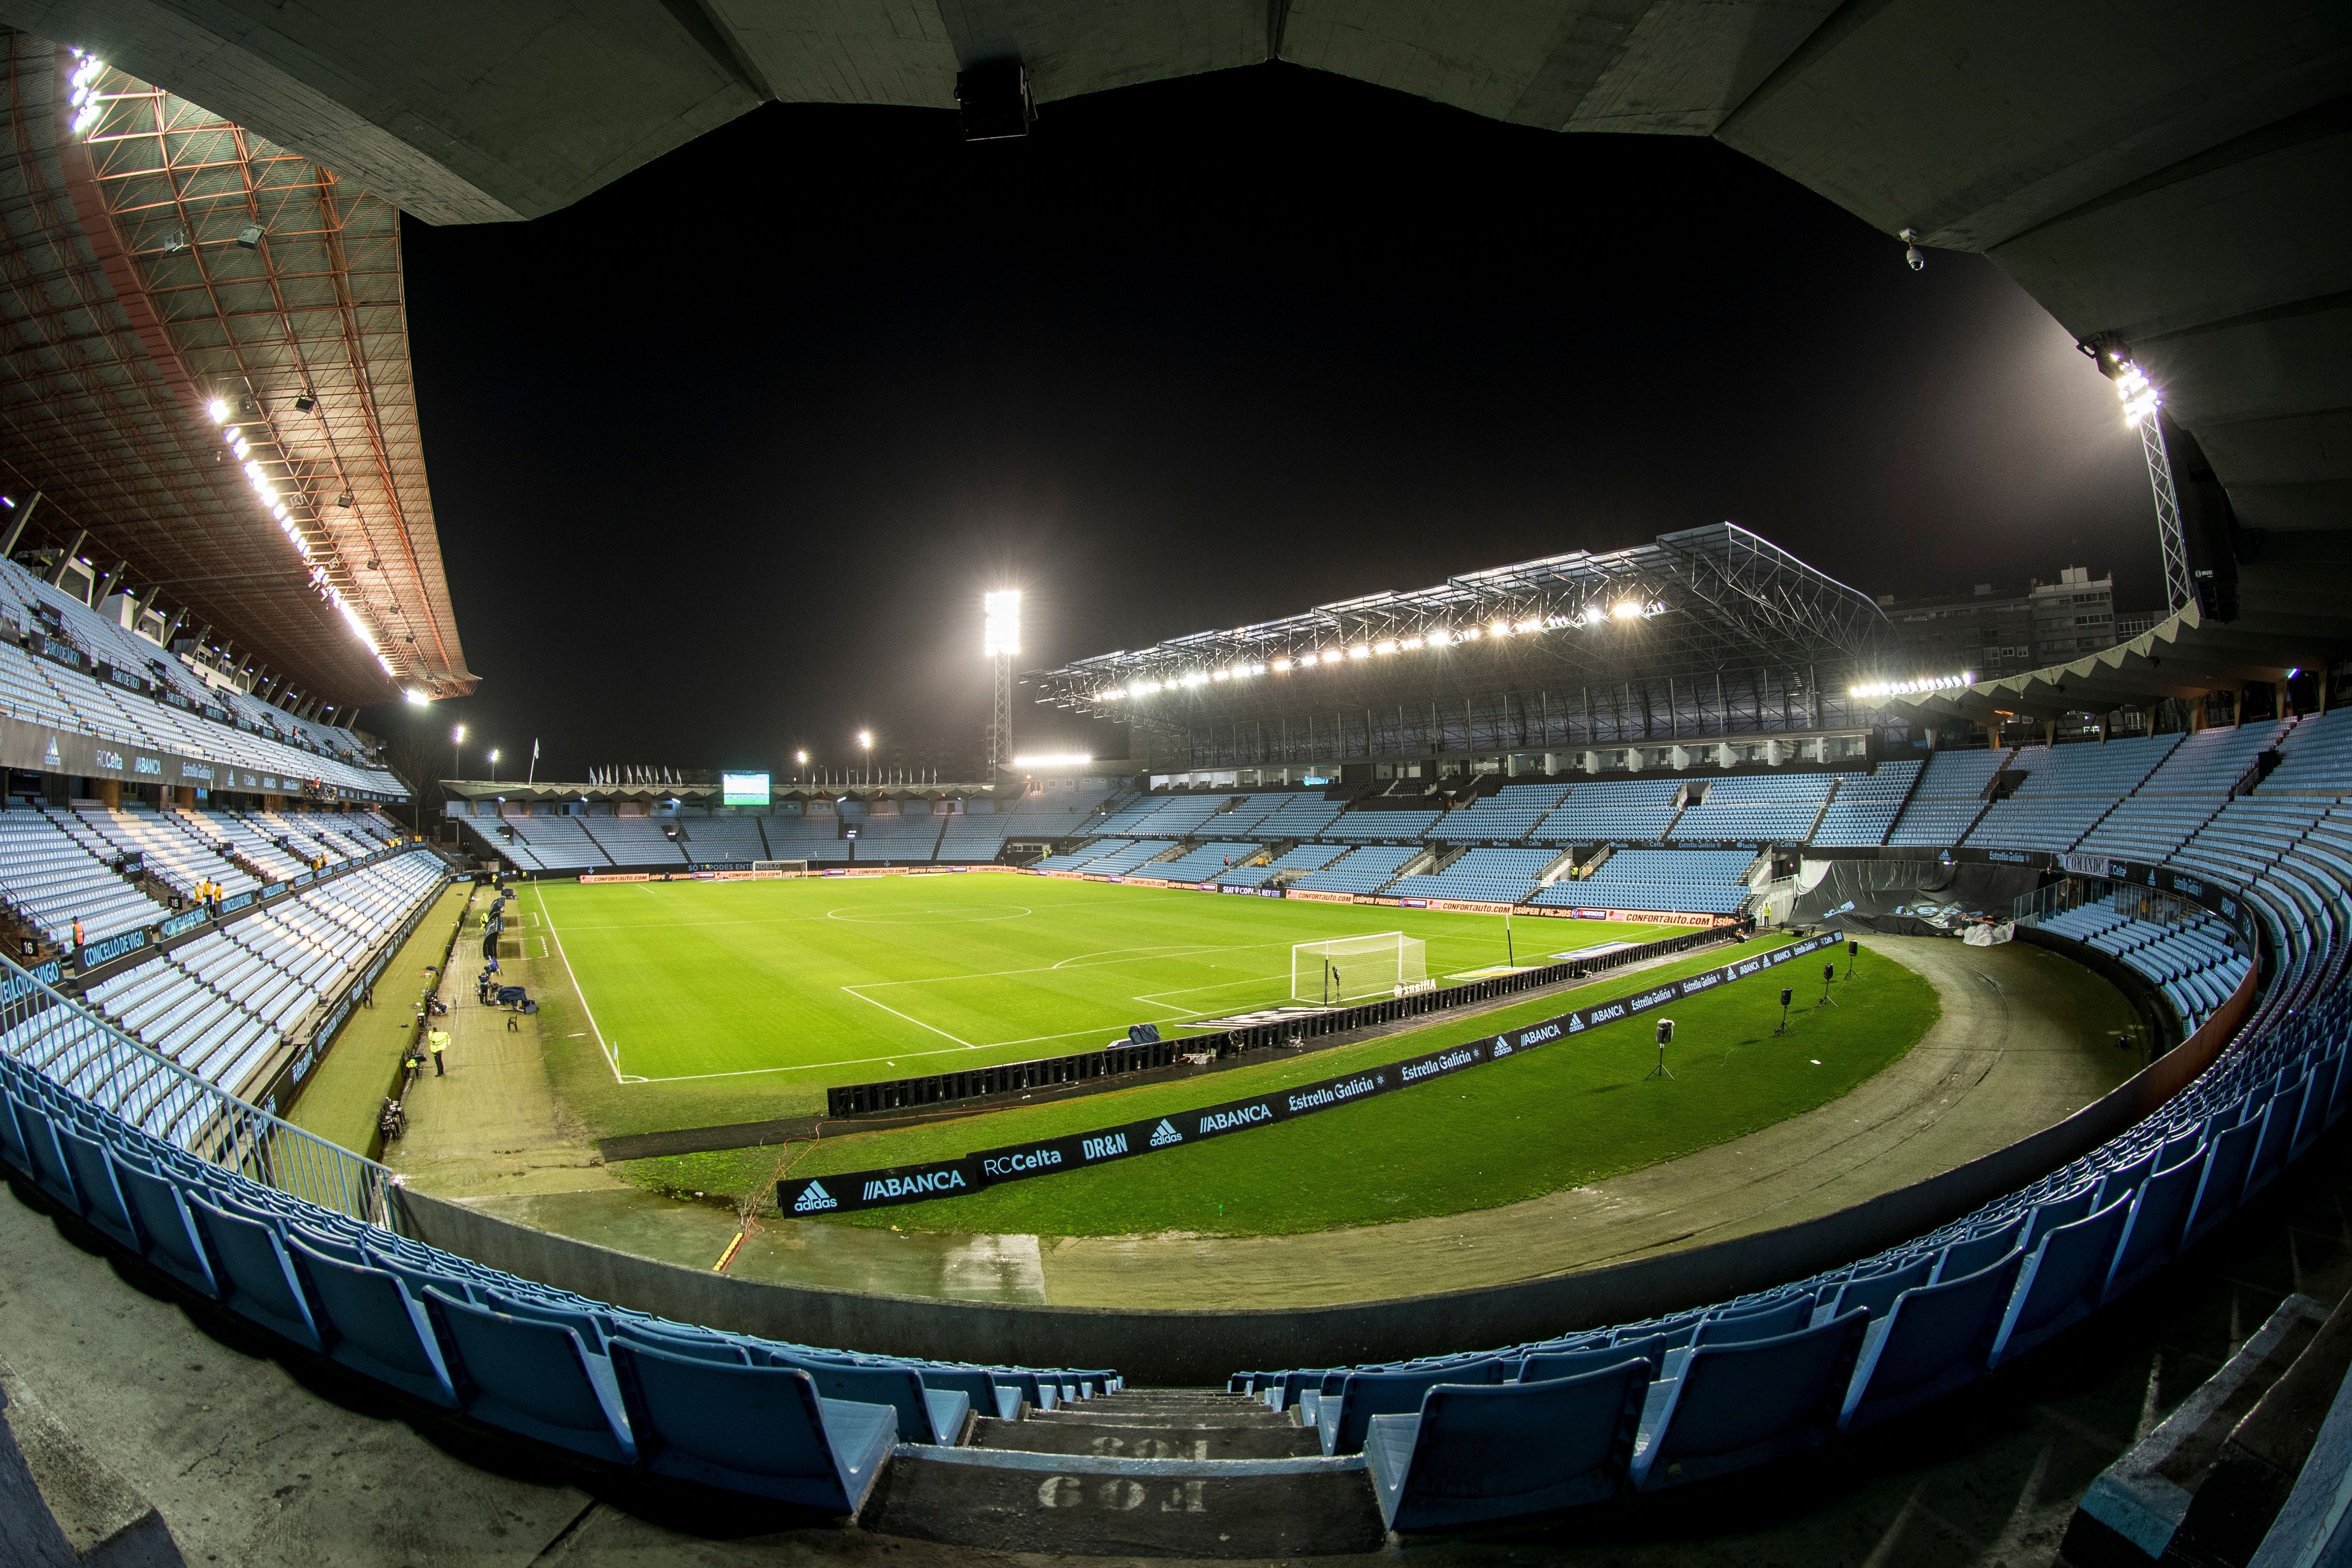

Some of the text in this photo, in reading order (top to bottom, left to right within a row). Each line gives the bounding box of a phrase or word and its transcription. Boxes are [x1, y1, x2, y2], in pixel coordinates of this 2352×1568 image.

[45, 637, 59, 657] FARO
[66, 647, 80, 665] VIGO
[112, 668, 122, 683] FARO
[128, 674, 140, 689] VIGO
[1989, 851, 2008, 861] Estrella
[24, 941, 33, 954] 16
[85, 930, 144, 967] CONCELLO DE VIGO
[794, 1197, 837, 1212] adidas
[984, 1149, 1062, 1176] RCCelta
[1082, 1133, 1128, 1160] DR&N
[1150, 1132, 1182, 1147] adidas
[1289, 1089, 1334, 1112] Estrella
[1335, 1077, 1374, 1099] Galicia
[1402, 1060, 1440, 1081] Estrella
[1439, 1050, 1472, 1070] Galicia
[1494, 1045, 1512, 1057] adidas
[1569, 1023, 1584, 1033] adidas
[1631, 995, 1653, 1011] Estrella
[1652, 988, 1671, 1004] Galicia
[1683, 979, 1702, 993] Estrella
[1701, 974, 1717, 987] Galicia
